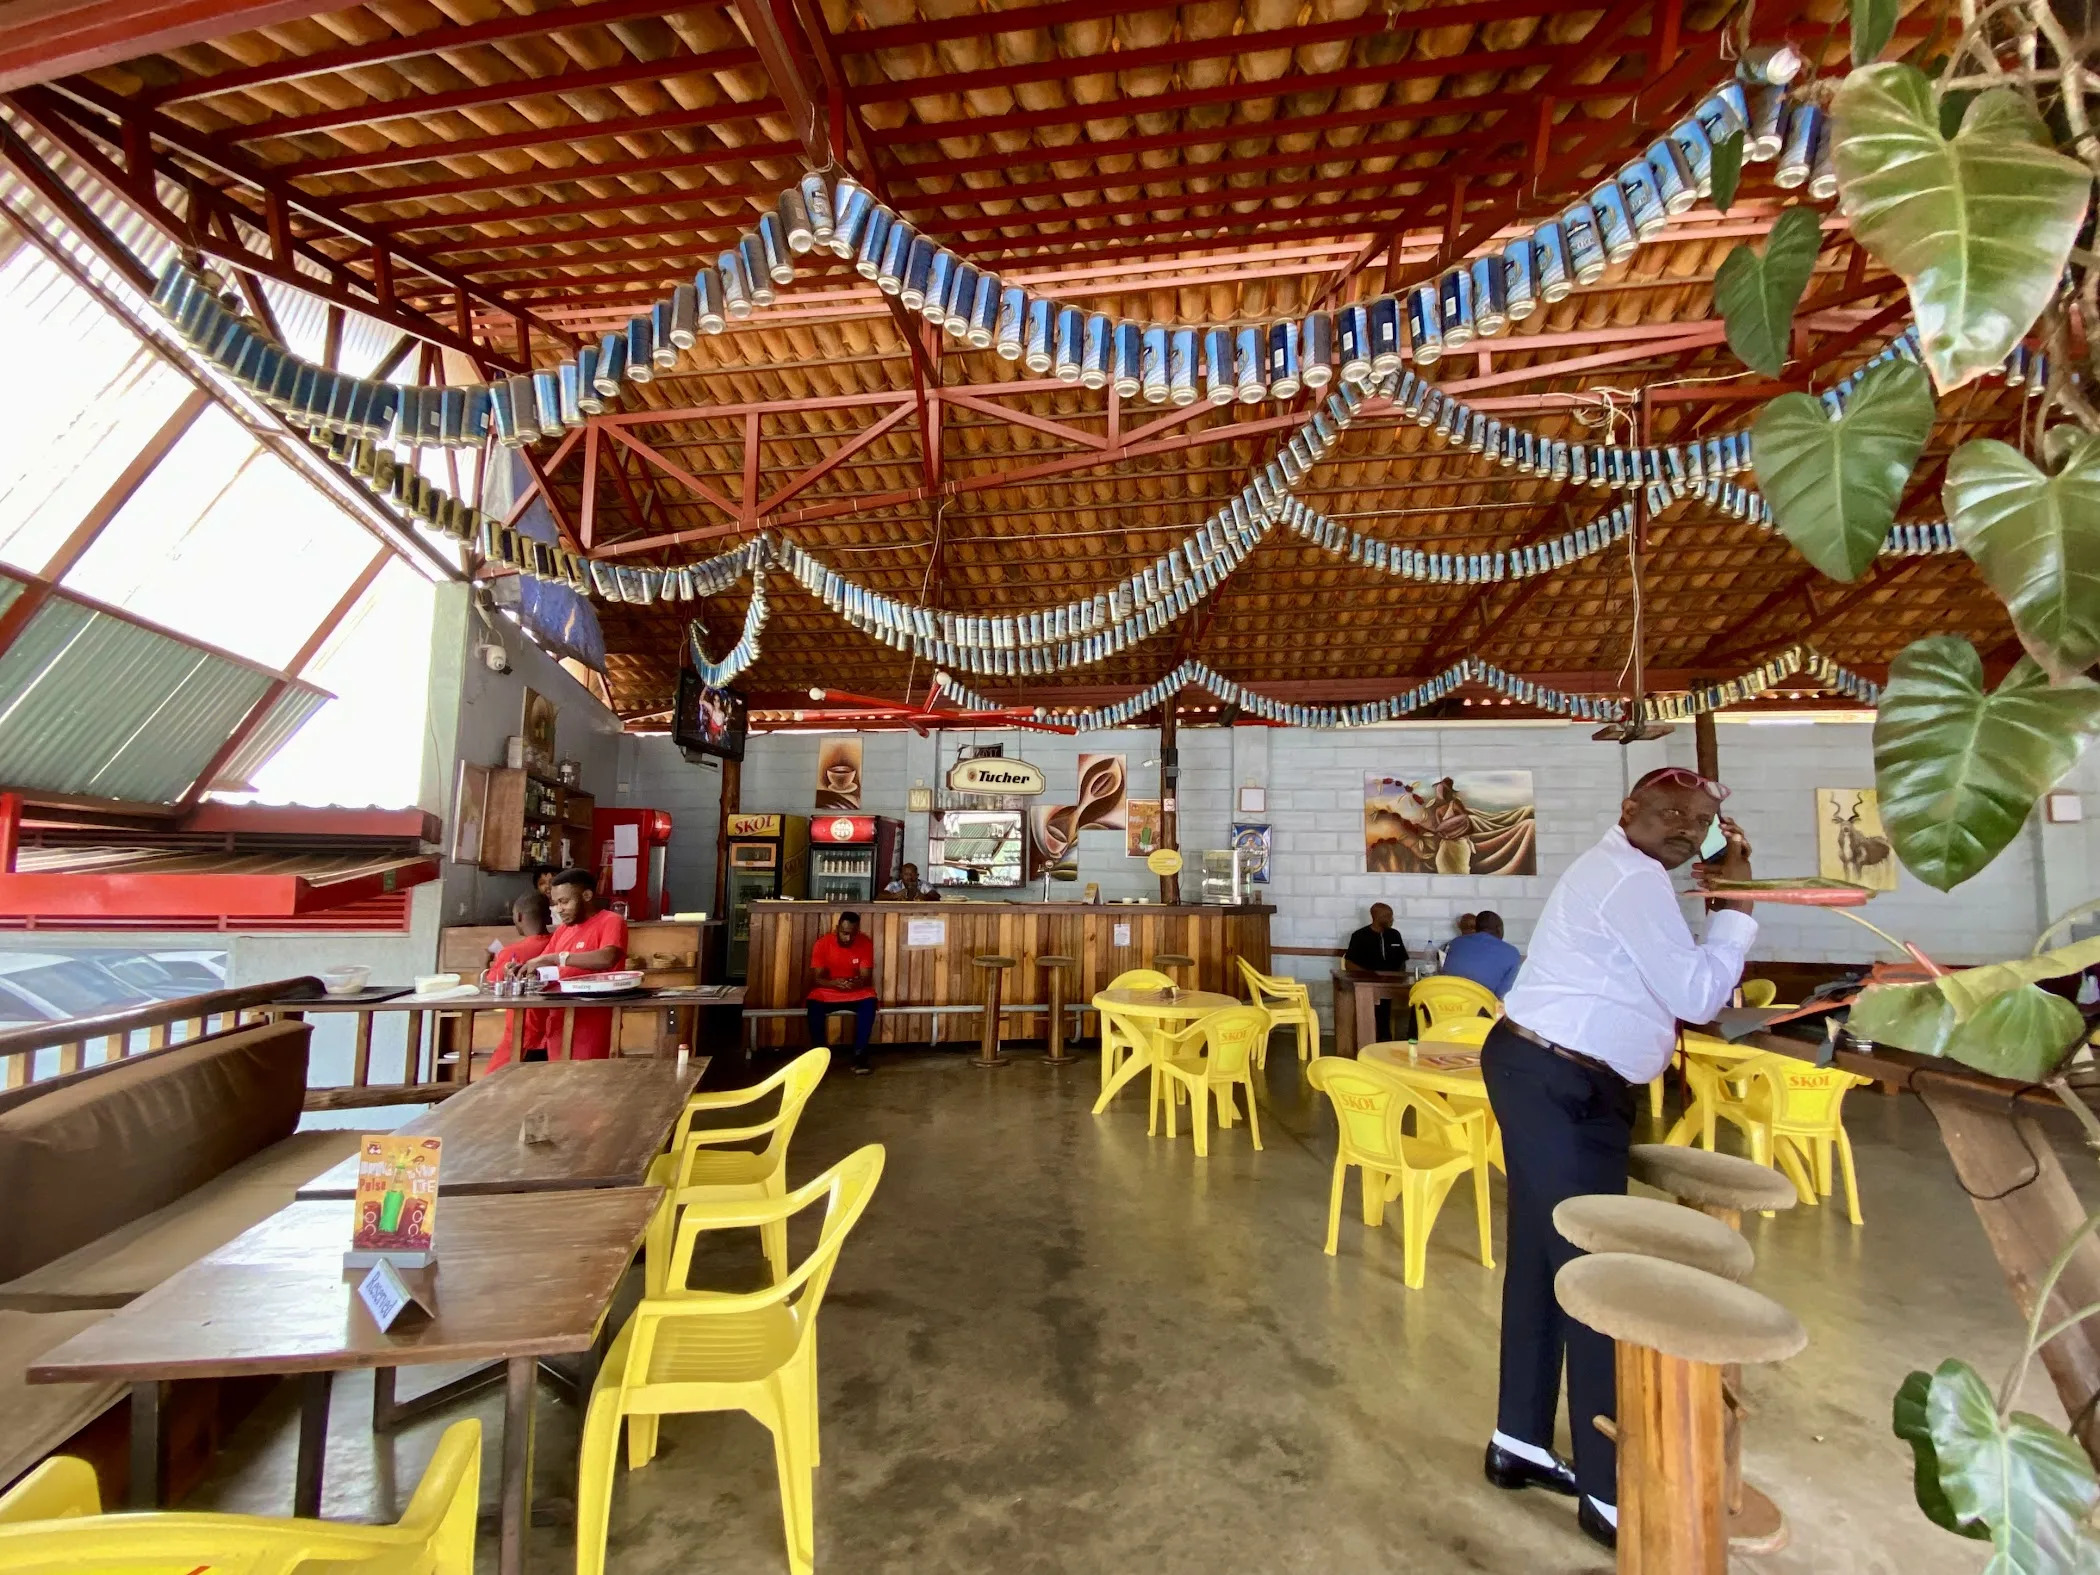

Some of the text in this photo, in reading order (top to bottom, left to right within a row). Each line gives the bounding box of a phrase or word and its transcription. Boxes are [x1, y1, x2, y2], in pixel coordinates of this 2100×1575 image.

[979, 770, 1030, 784] Tucher
[735, 815, 775, 835] SKOL
[1438, 1004, 1464, 1013] SKOL
[1221, 1030, 1247, 1041] SKOL
[1789, 1075, 1832, 1088] SKOL
[1341, 1093, 1377, 1111] SKOL
[366, 1270, 399, 1319] Reserved
